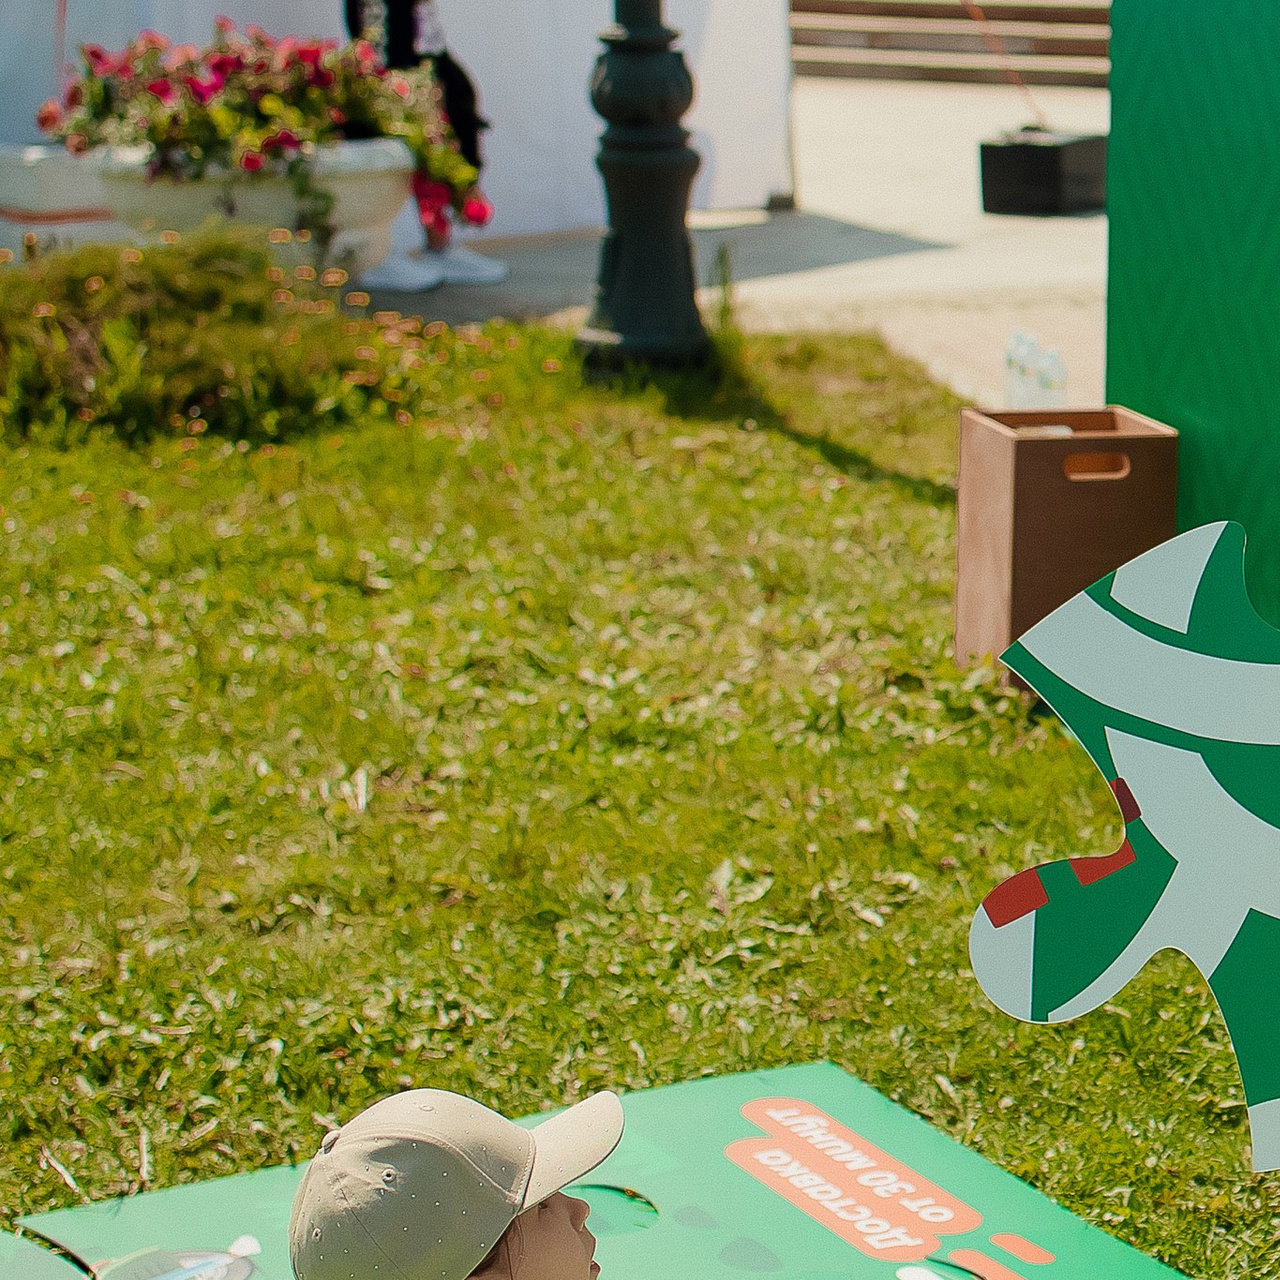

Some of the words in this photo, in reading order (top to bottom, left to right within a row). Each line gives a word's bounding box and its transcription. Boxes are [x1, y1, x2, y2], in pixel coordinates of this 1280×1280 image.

[765, 1106, 877, 1172] минут
[858, 1169, 917, 1199] 30
[900, 1197, 955, 1223] от
